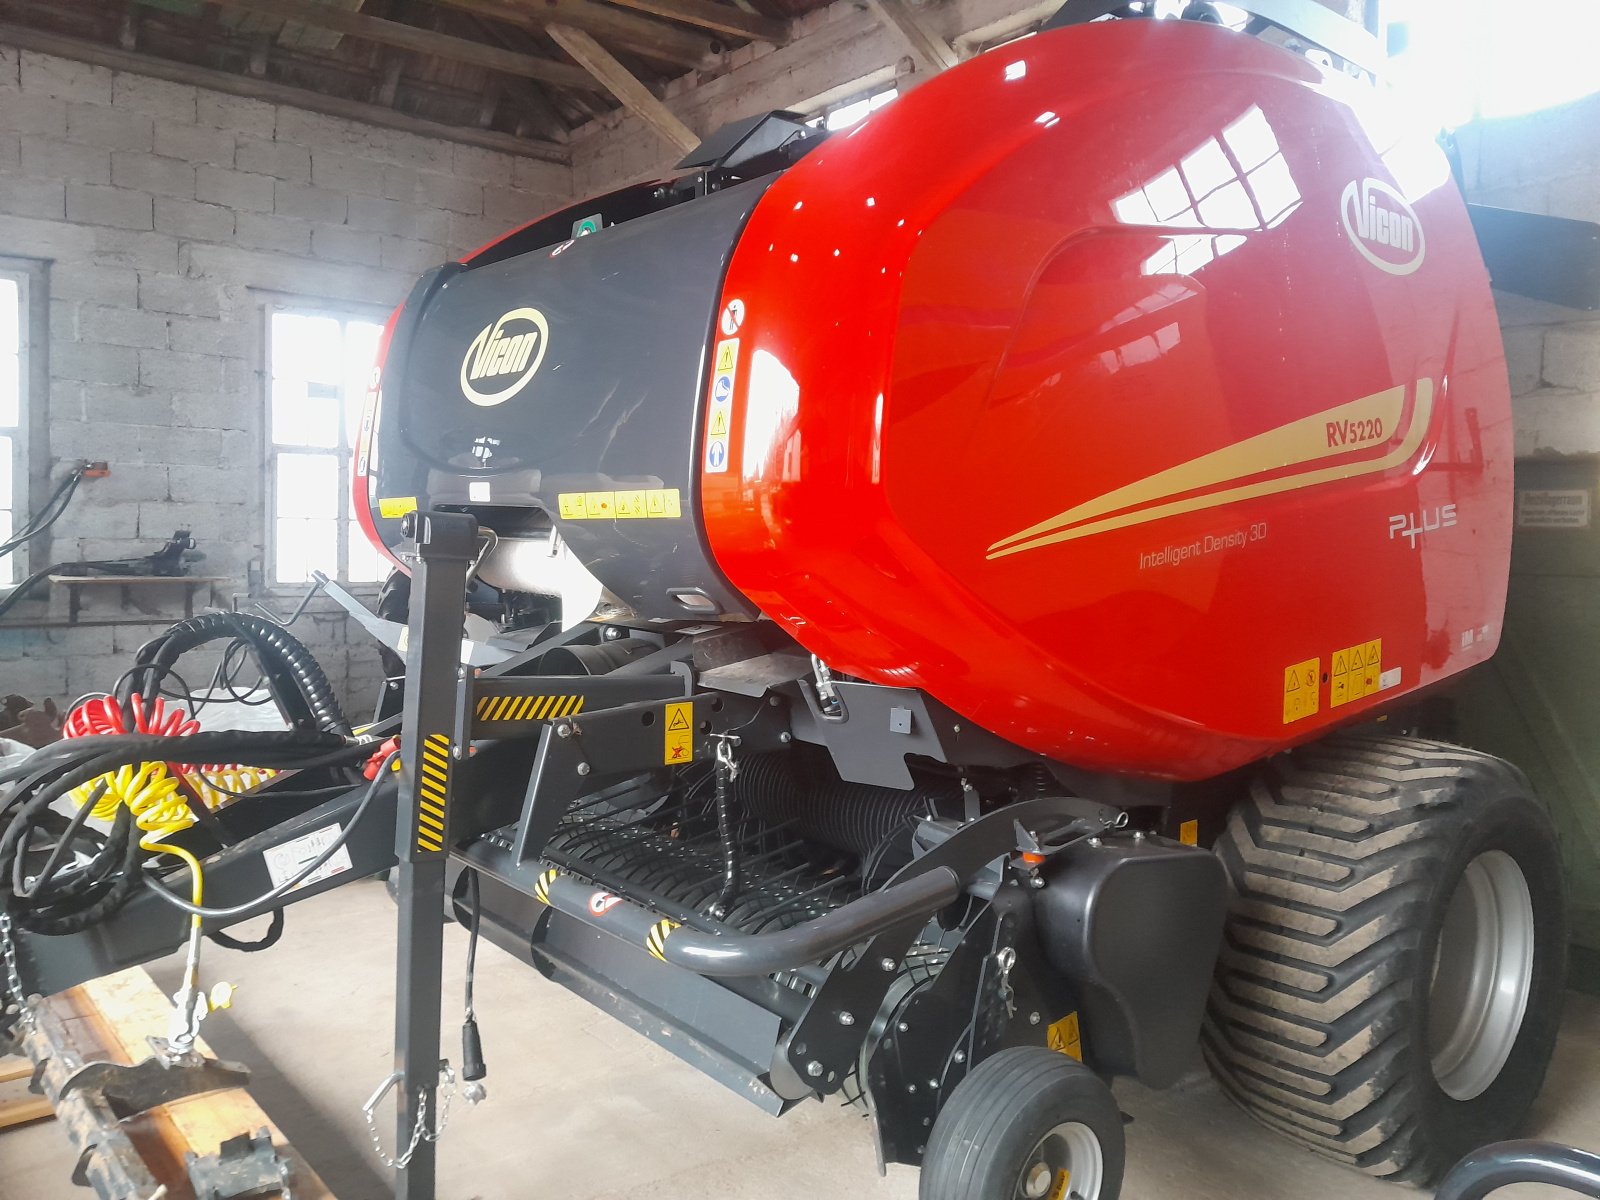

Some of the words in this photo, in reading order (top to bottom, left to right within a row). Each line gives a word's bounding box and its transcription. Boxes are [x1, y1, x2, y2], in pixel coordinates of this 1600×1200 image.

[1354, 179, 1415, 256] Vicon
[466, 318, 540, 384] Vicon
[1326, 417, 1383, 448] RV5220
[1139, 540, 1201, 570] Intelligent
[1204, 529, 1248, 553] Density
[1250, 522, 1267, 542] 3D
